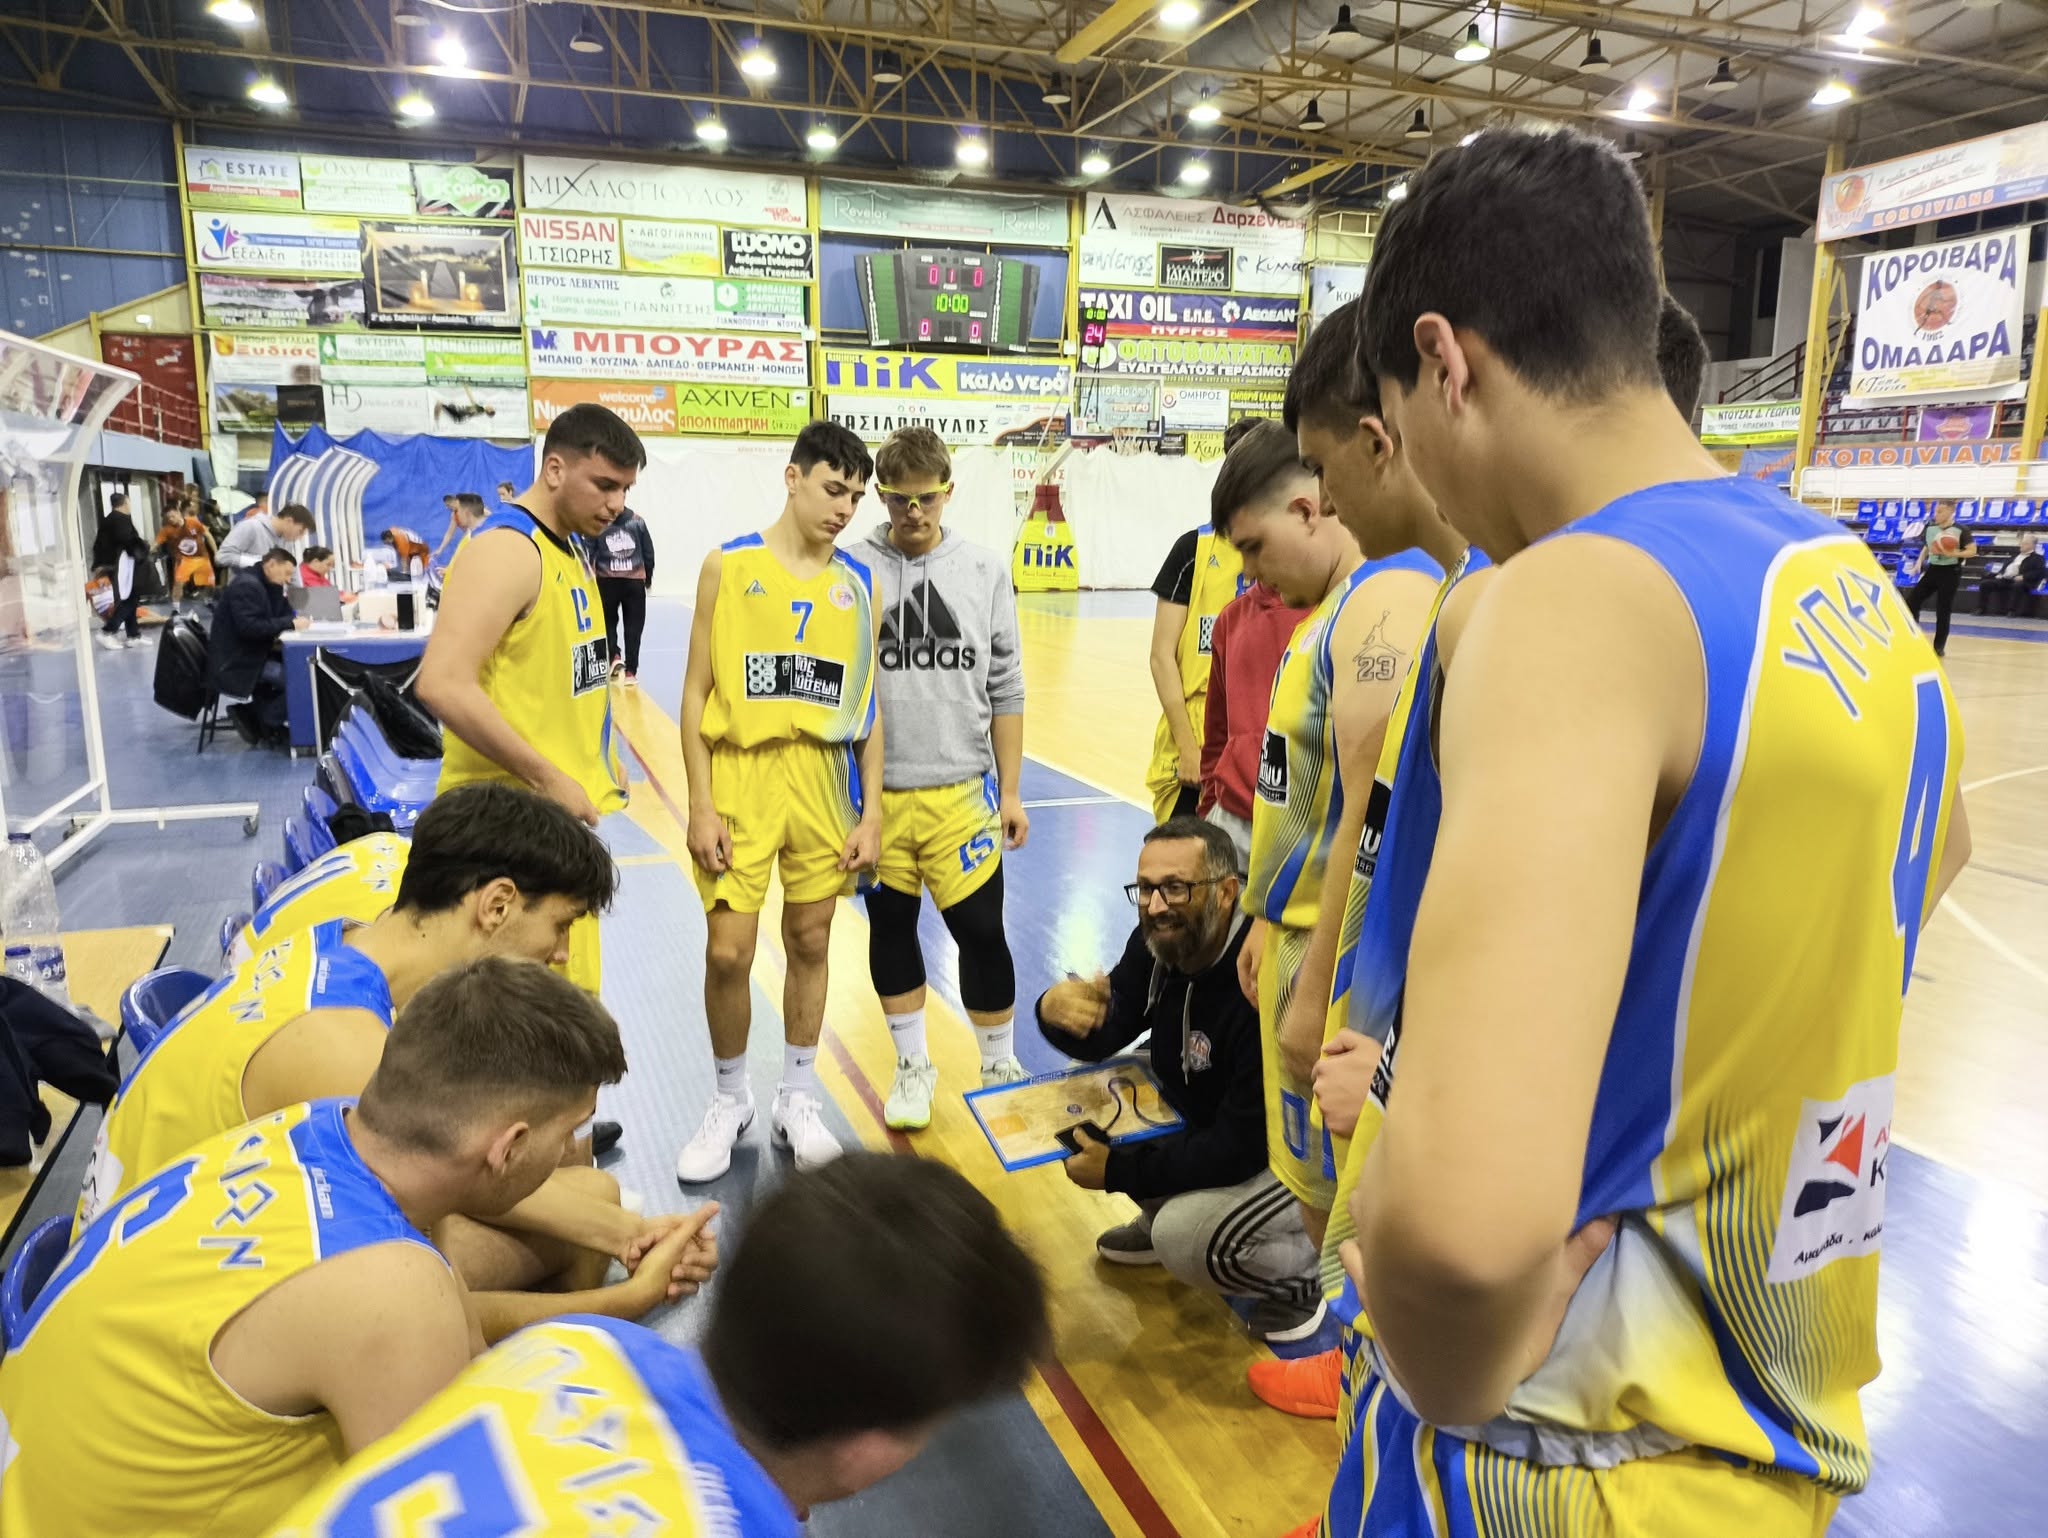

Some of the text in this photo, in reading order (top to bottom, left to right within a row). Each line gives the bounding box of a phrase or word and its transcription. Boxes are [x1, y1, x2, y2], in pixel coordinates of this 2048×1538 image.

[226, 161, 289, 177] ESTATE
[1873, 188, 1994, 228] KOROIVIANS
[524, 218, 615, 243] NISSAN
[929, 265, 938, 284] 0
[973, 268, 983, 287] 0
[1866, 234, 2017, 311] ΚΟΡΟΙΒΑΡΑ
[624, 301, 713, 314] ΓΙΑΝΝΙΤΣΗΣ
[936, 294, 968, 313] 10:00
[1139, 294, 1178, 322] OIL
[1085, 324, 1103, 343] 24
[1151, 325, 1229, 338] ΠΥΡΓΟΣ
[574, 331, 803, 362] ΜΠΟΥΡΑΣ
[1861, 320, 2011, 371] ΟΜΑΔΑΡΑ
[538, 355, 804, 375] ΜΠΑΝΙΟ ΚΟΥΖΙΝΑ ΔΑΠΕΔΟ ΘΕΡΜΑΝΣΗ ΜΟΝΩΣΗ
[1118, 363, 1215, 375] ΕΥΑΓΓΕΛΑΤΟΣ
[682, 389, 790, 409] AXIVEN
[1180, 390, 1221, 400] ΟΜΗΡΟΣ
[1765, 406, 1801, 419] ΓΕΩΡΓΙΟ
[1815, 445, 2023, 466] KOROIVIANS
[791, 601, 814, 642] 7
[879, 638, 976, 671] adidas
[1357, 656, 1396, 682] 23
[954, 833, 997, 875] 15
